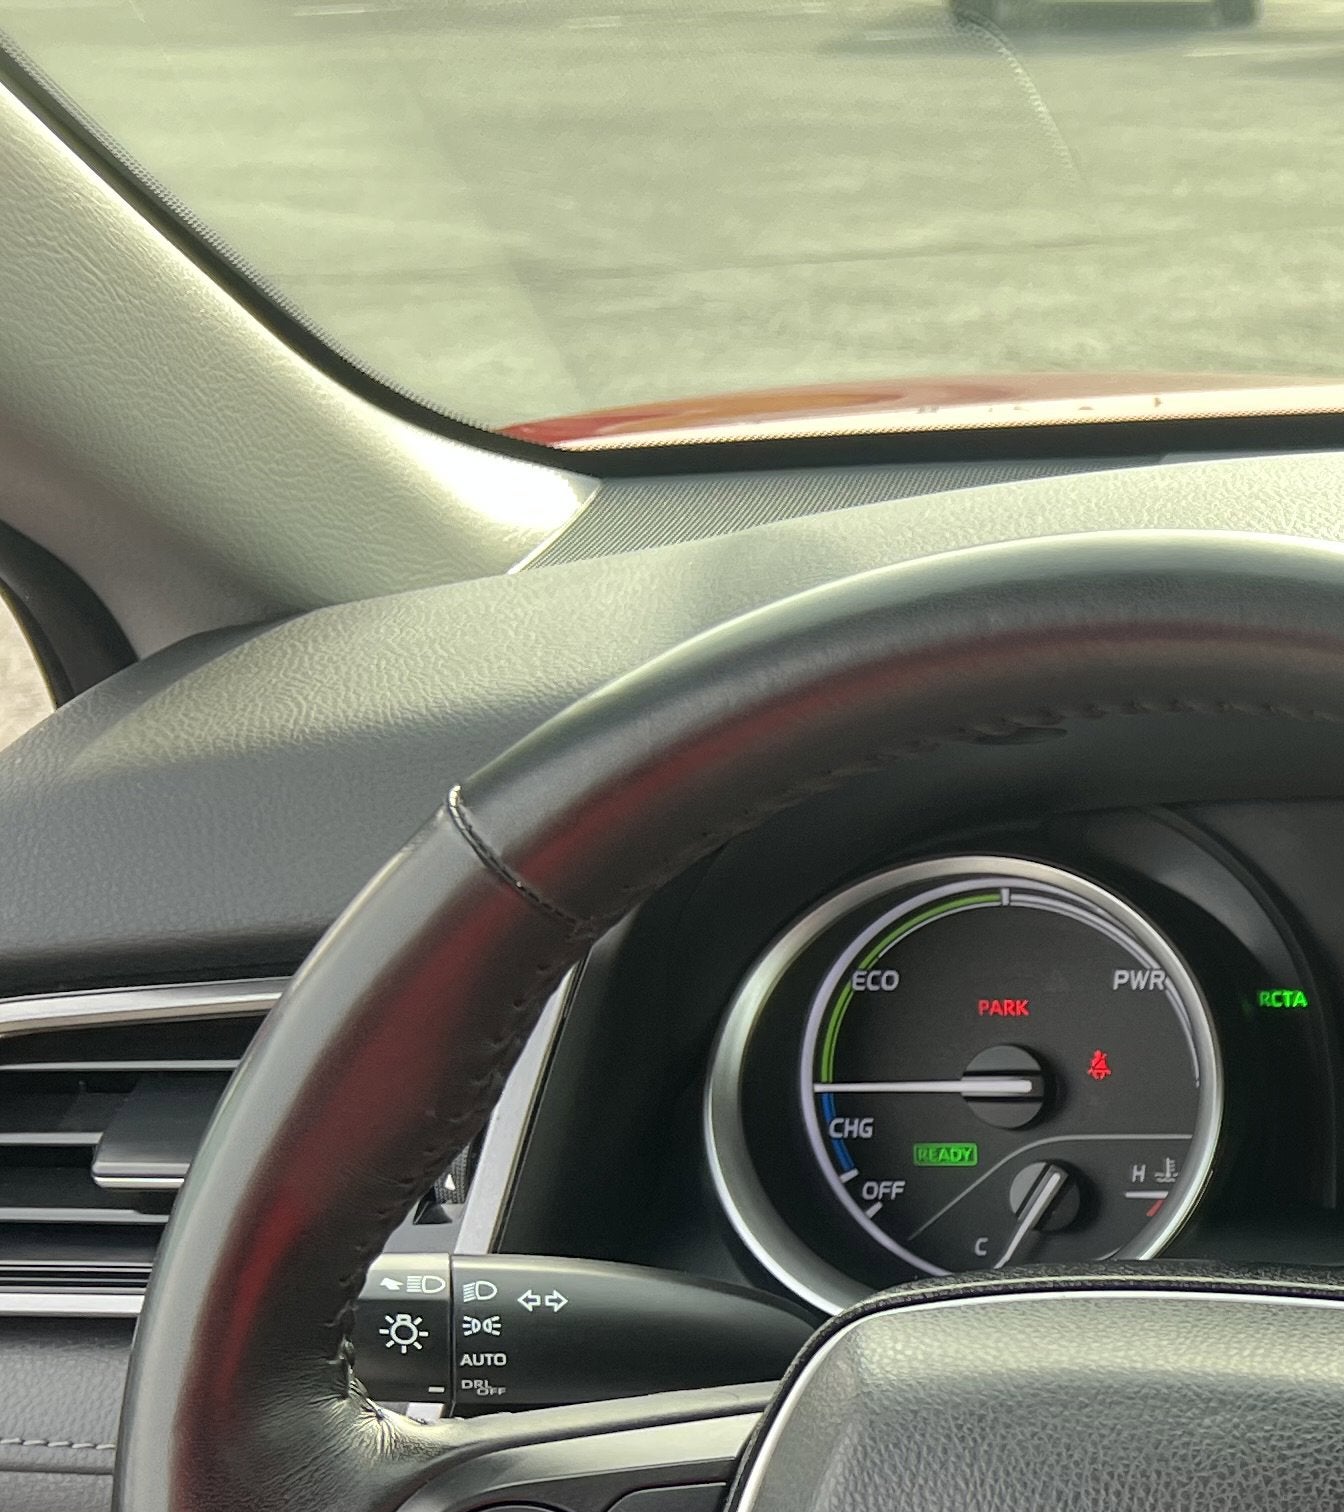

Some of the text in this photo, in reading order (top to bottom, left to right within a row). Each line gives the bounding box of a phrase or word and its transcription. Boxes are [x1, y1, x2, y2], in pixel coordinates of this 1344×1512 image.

[851, 969, 900, 991] ECO
[1112, 969, 1167, 991] PWR
[978, 999, 1030, 1017] PARK
[1258, 989, 1309, 1008] RCTA
[828, 1118, 874, 1140] CHG
[917, 1147, 973, 1164] READY
[1131, 1165, 1145, 1182] H
[862, 1180, 905, 1200] OFF
[974, 1237, 988, 1256] C
[460, 1353, 507, 1366] AUTO
[477, 1387, 507, 1396] OFF
